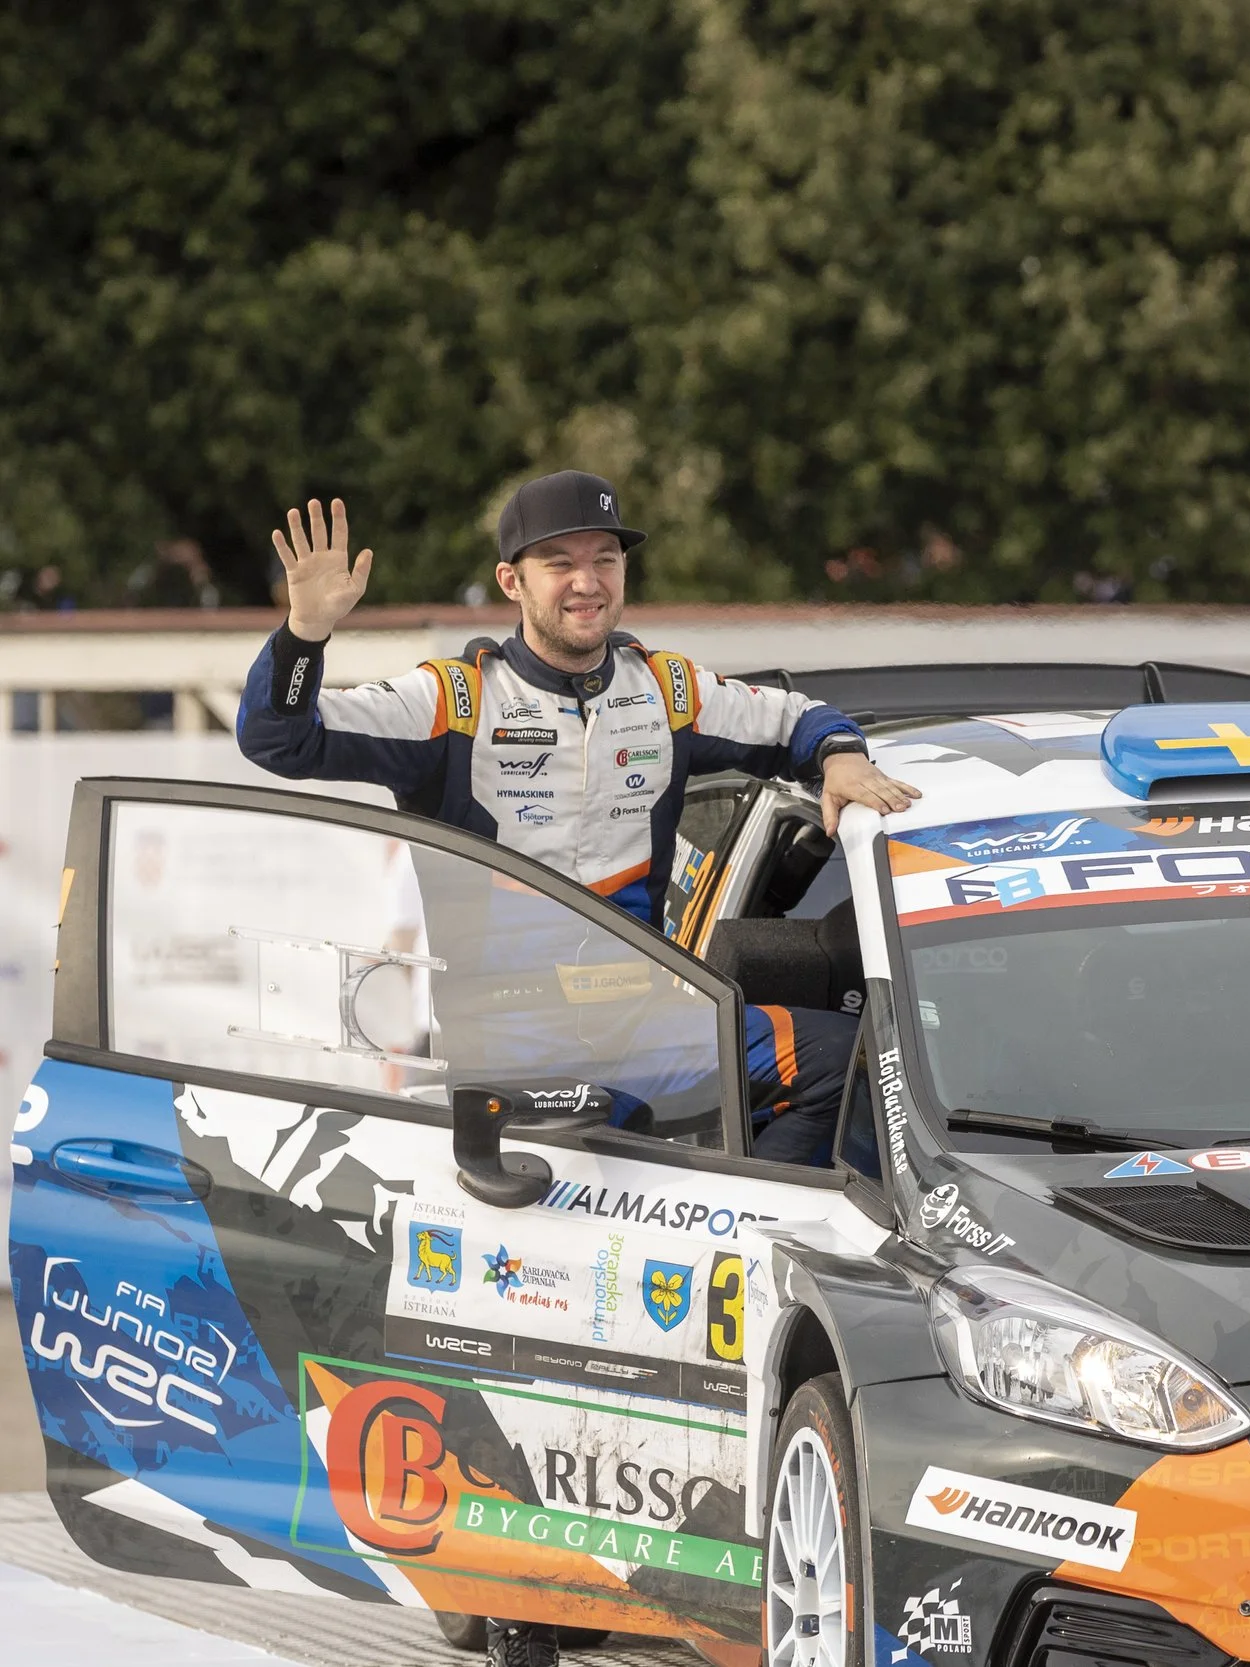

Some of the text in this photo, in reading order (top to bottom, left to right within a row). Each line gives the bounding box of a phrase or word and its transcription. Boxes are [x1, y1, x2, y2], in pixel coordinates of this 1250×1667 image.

[286, 656, 309, 706] sparco
[668, 660, 688, 712] sparco
[447, 665, 472, 717] sparco
[502, 708, 543, 719] WRC
[610, 724, 648, 736] M-SPORT
[628, 749, 659, 758] CARLSSON
[497, 790, 554, 799] HYRMASKINER
[622, 807, 639, 815] Forss
[967, 843, 1046, 858] LUBRICANTS
[534, 1100, 576, 1109] LUBRICANTS
[413, 1201, 466, 1219] ISTARSKA
[946, 1204, 1016, 1256] Forss IT
[522, 1266, 570, 1281] KARLOVAČKA
[116, 1281, 165, 1317] FIA
[403, 1301, 457, 1318] ISTRIANA
[52, 1289, 218, 1377] JUNIOR
[426, 1333, 492, 1356] WRC2
[534, 1354, 582, 1368] BEYOND
[30, 1312, 223, 1435] WRC
[467, 1501, 684, 1566] BYGGARE
[933, 1616, 959, 1641] M
[937, 1643, 972, 1654] POLAND
